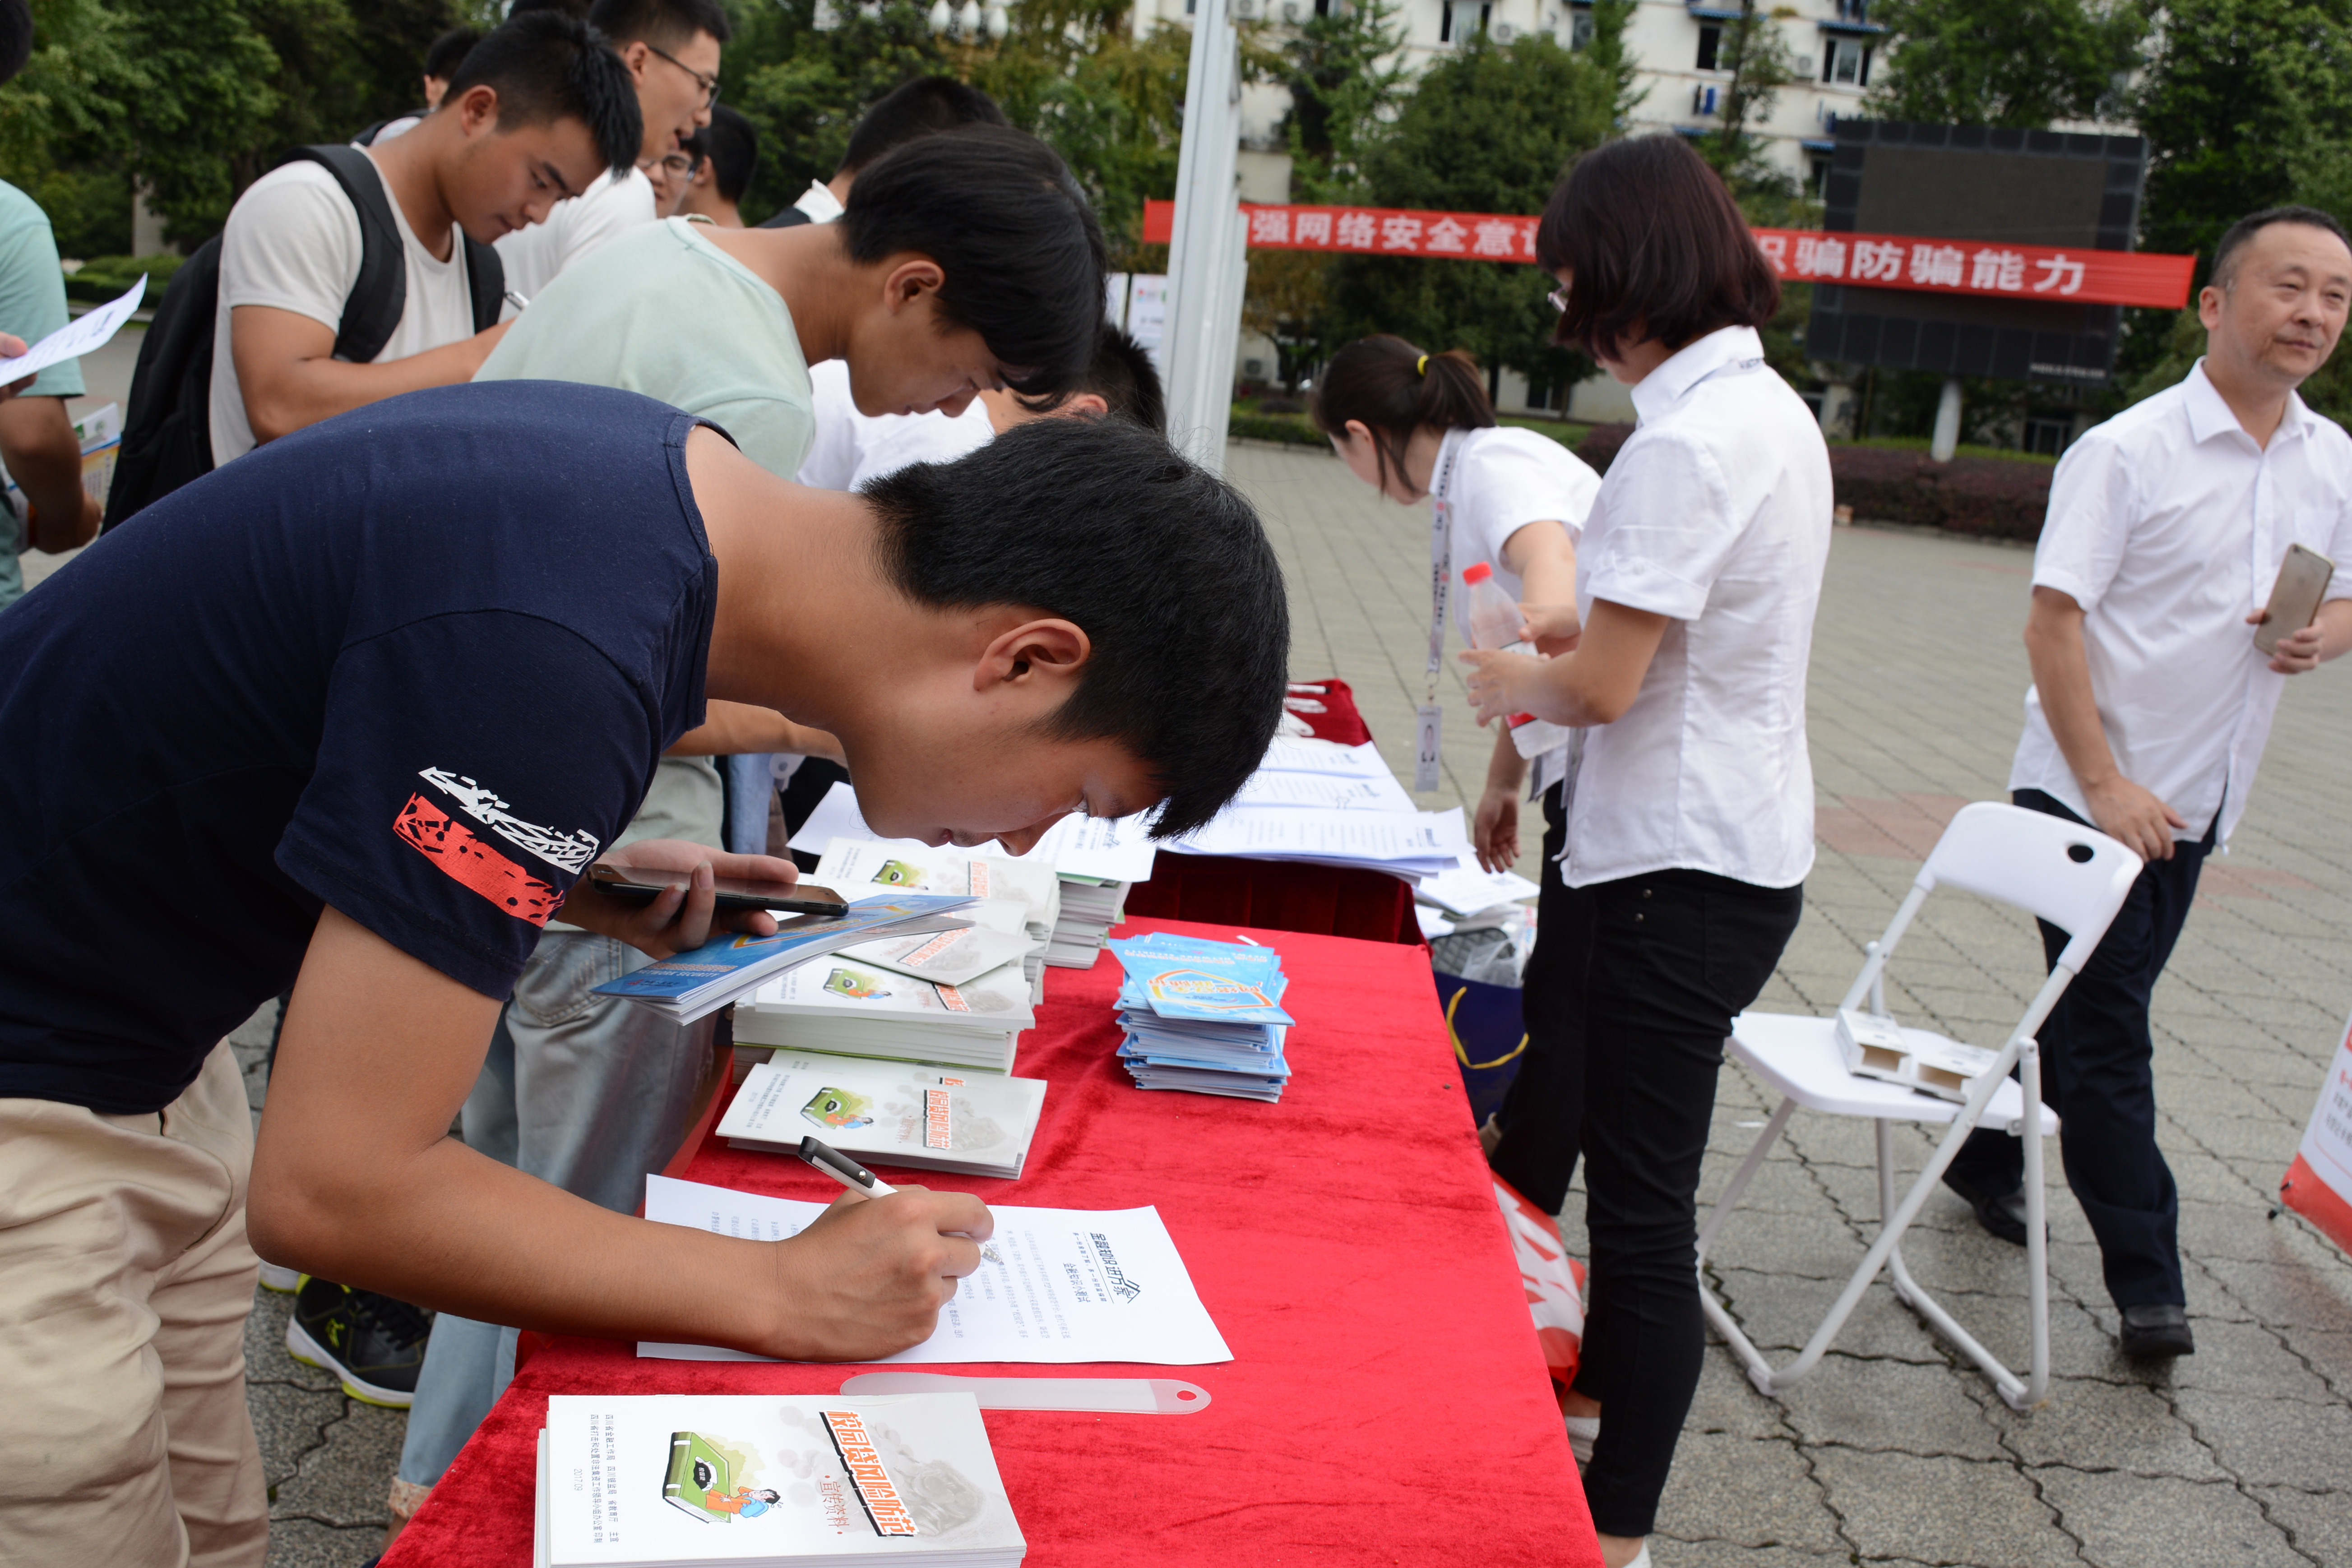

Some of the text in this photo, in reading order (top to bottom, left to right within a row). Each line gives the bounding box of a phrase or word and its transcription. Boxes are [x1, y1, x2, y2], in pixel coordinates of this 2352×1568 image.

[605, 1414, 616, 1460] 四川省金融工作局
[574, 1468, 583, 1491] 2017.09
[607, 1466, 617, 1495] 四川银监局
[826, 1411, 916, 1535] 校园贷风险防范
[607, 1499, 618, 1522] 省教育厅
[819, 1481, 850, 1528] 宣传资料
